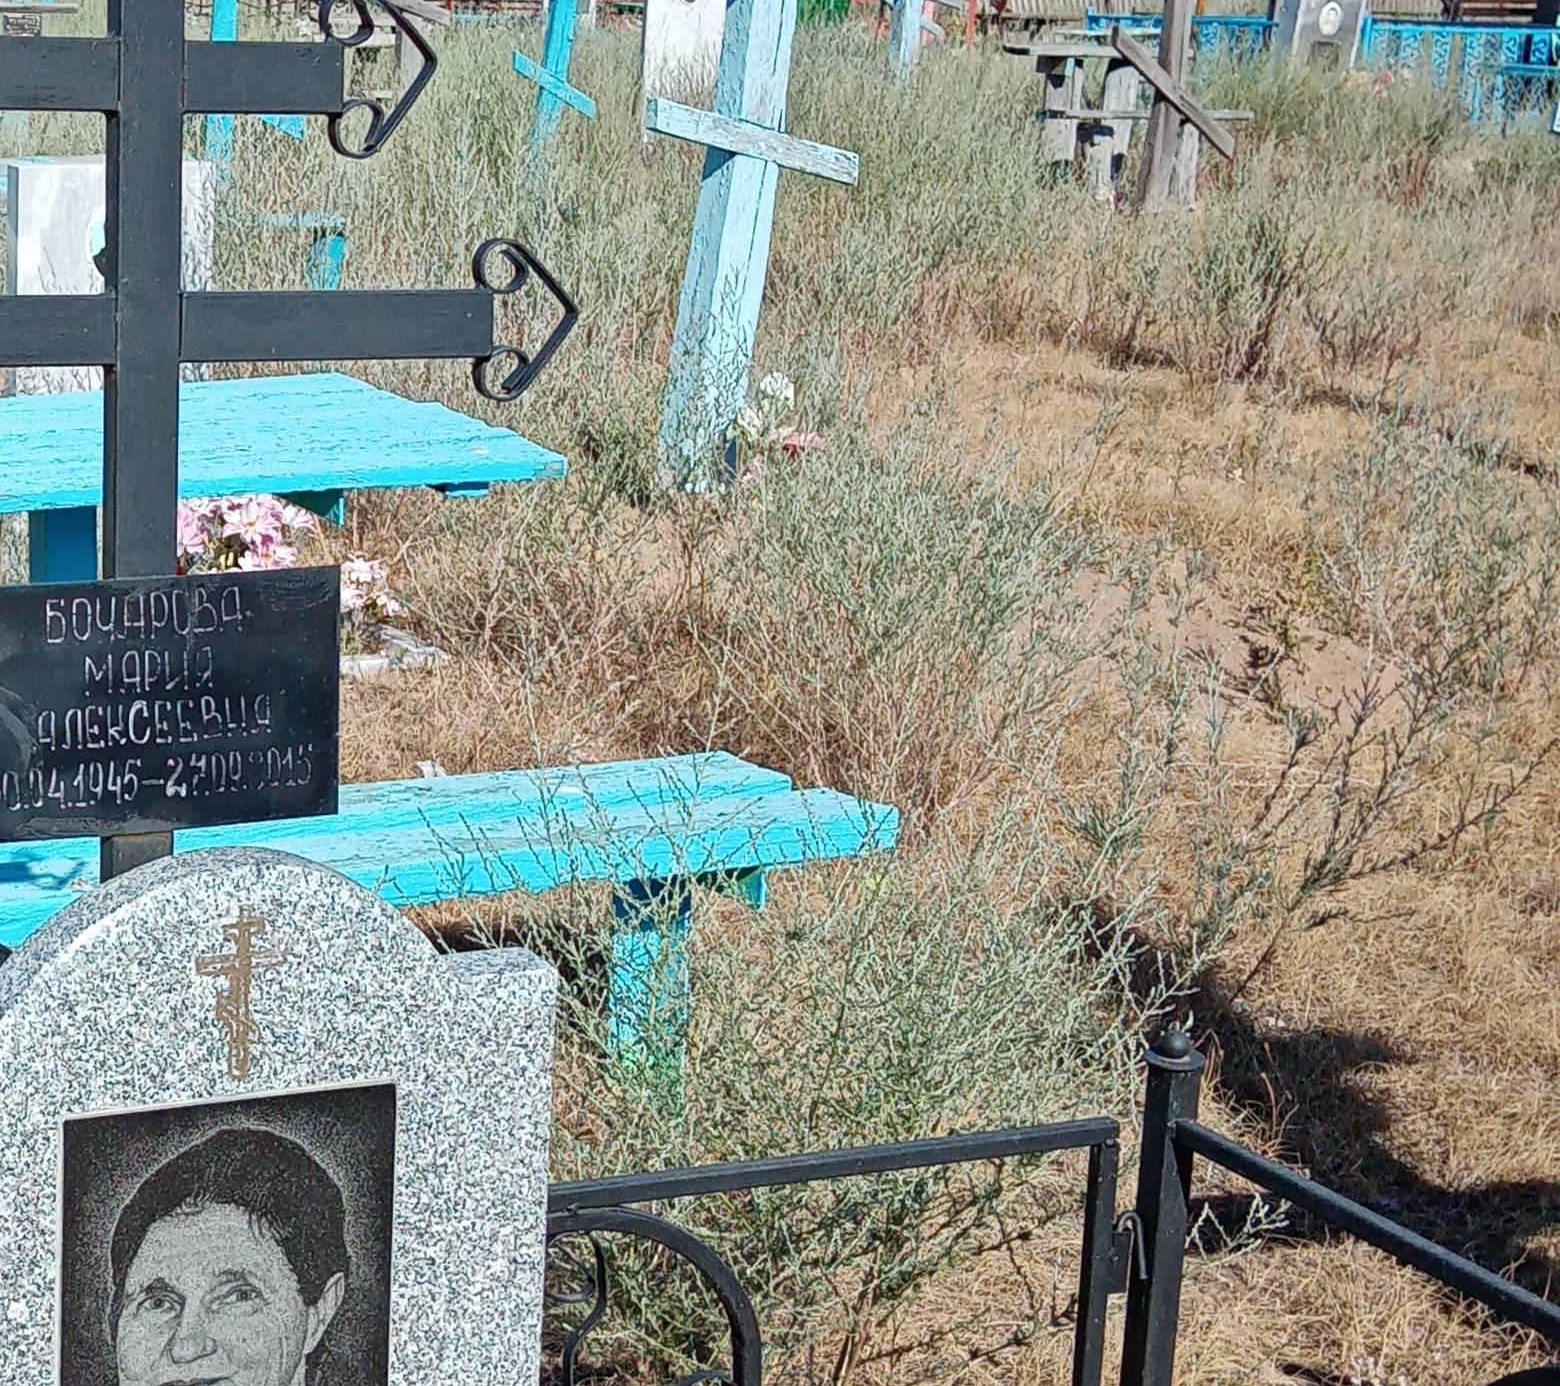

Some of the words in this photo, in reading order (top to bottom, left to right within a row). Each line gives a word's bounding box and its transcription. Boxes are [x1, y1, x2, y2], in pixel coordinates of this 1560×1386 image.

[45, 585, 243, 643] БОЧАРОВА
[84, 645, 215, 696] МАРИЯ
[33, 693, 273, 751] АЛЕКСЕЕВНА
